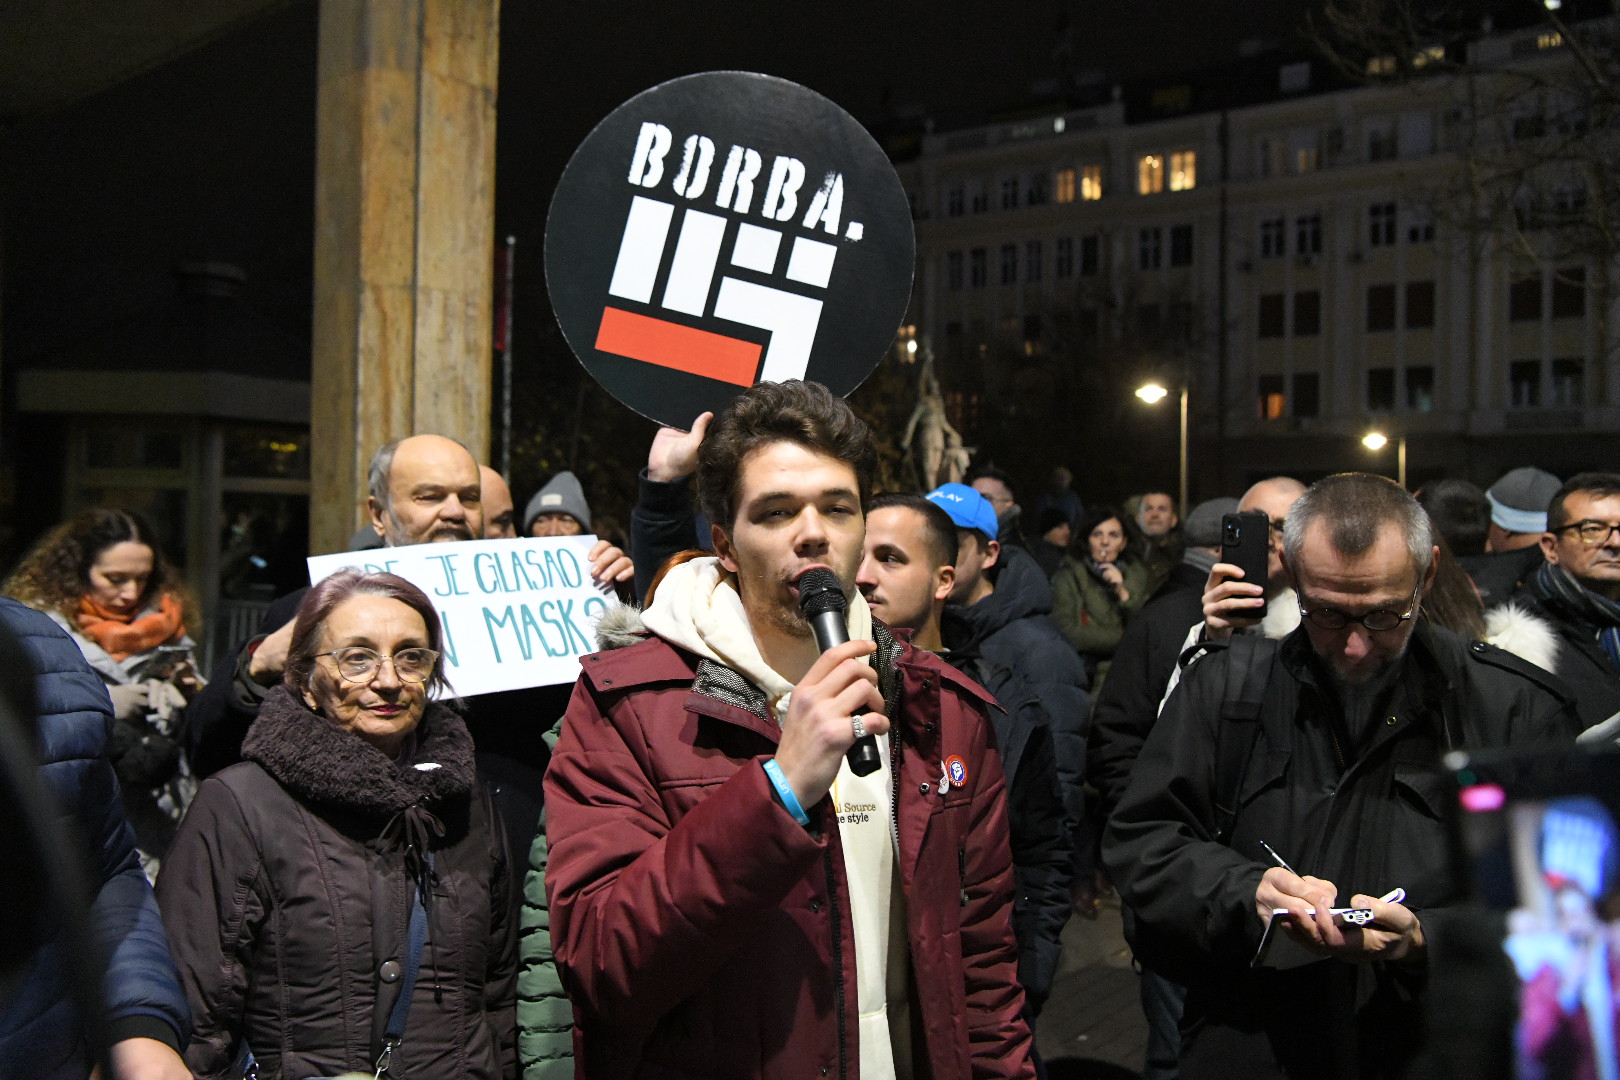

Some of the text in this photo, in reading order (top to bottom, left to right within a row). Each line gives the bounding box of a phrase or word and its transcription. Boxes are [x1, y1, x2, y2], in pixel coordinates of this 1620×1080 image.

[628, 122, 864, 242] BORBA.
[425, 548, 583, 597] JE GLASAO
[844, 803, 877, 813] Source
[847, 813, 869, 824] style
